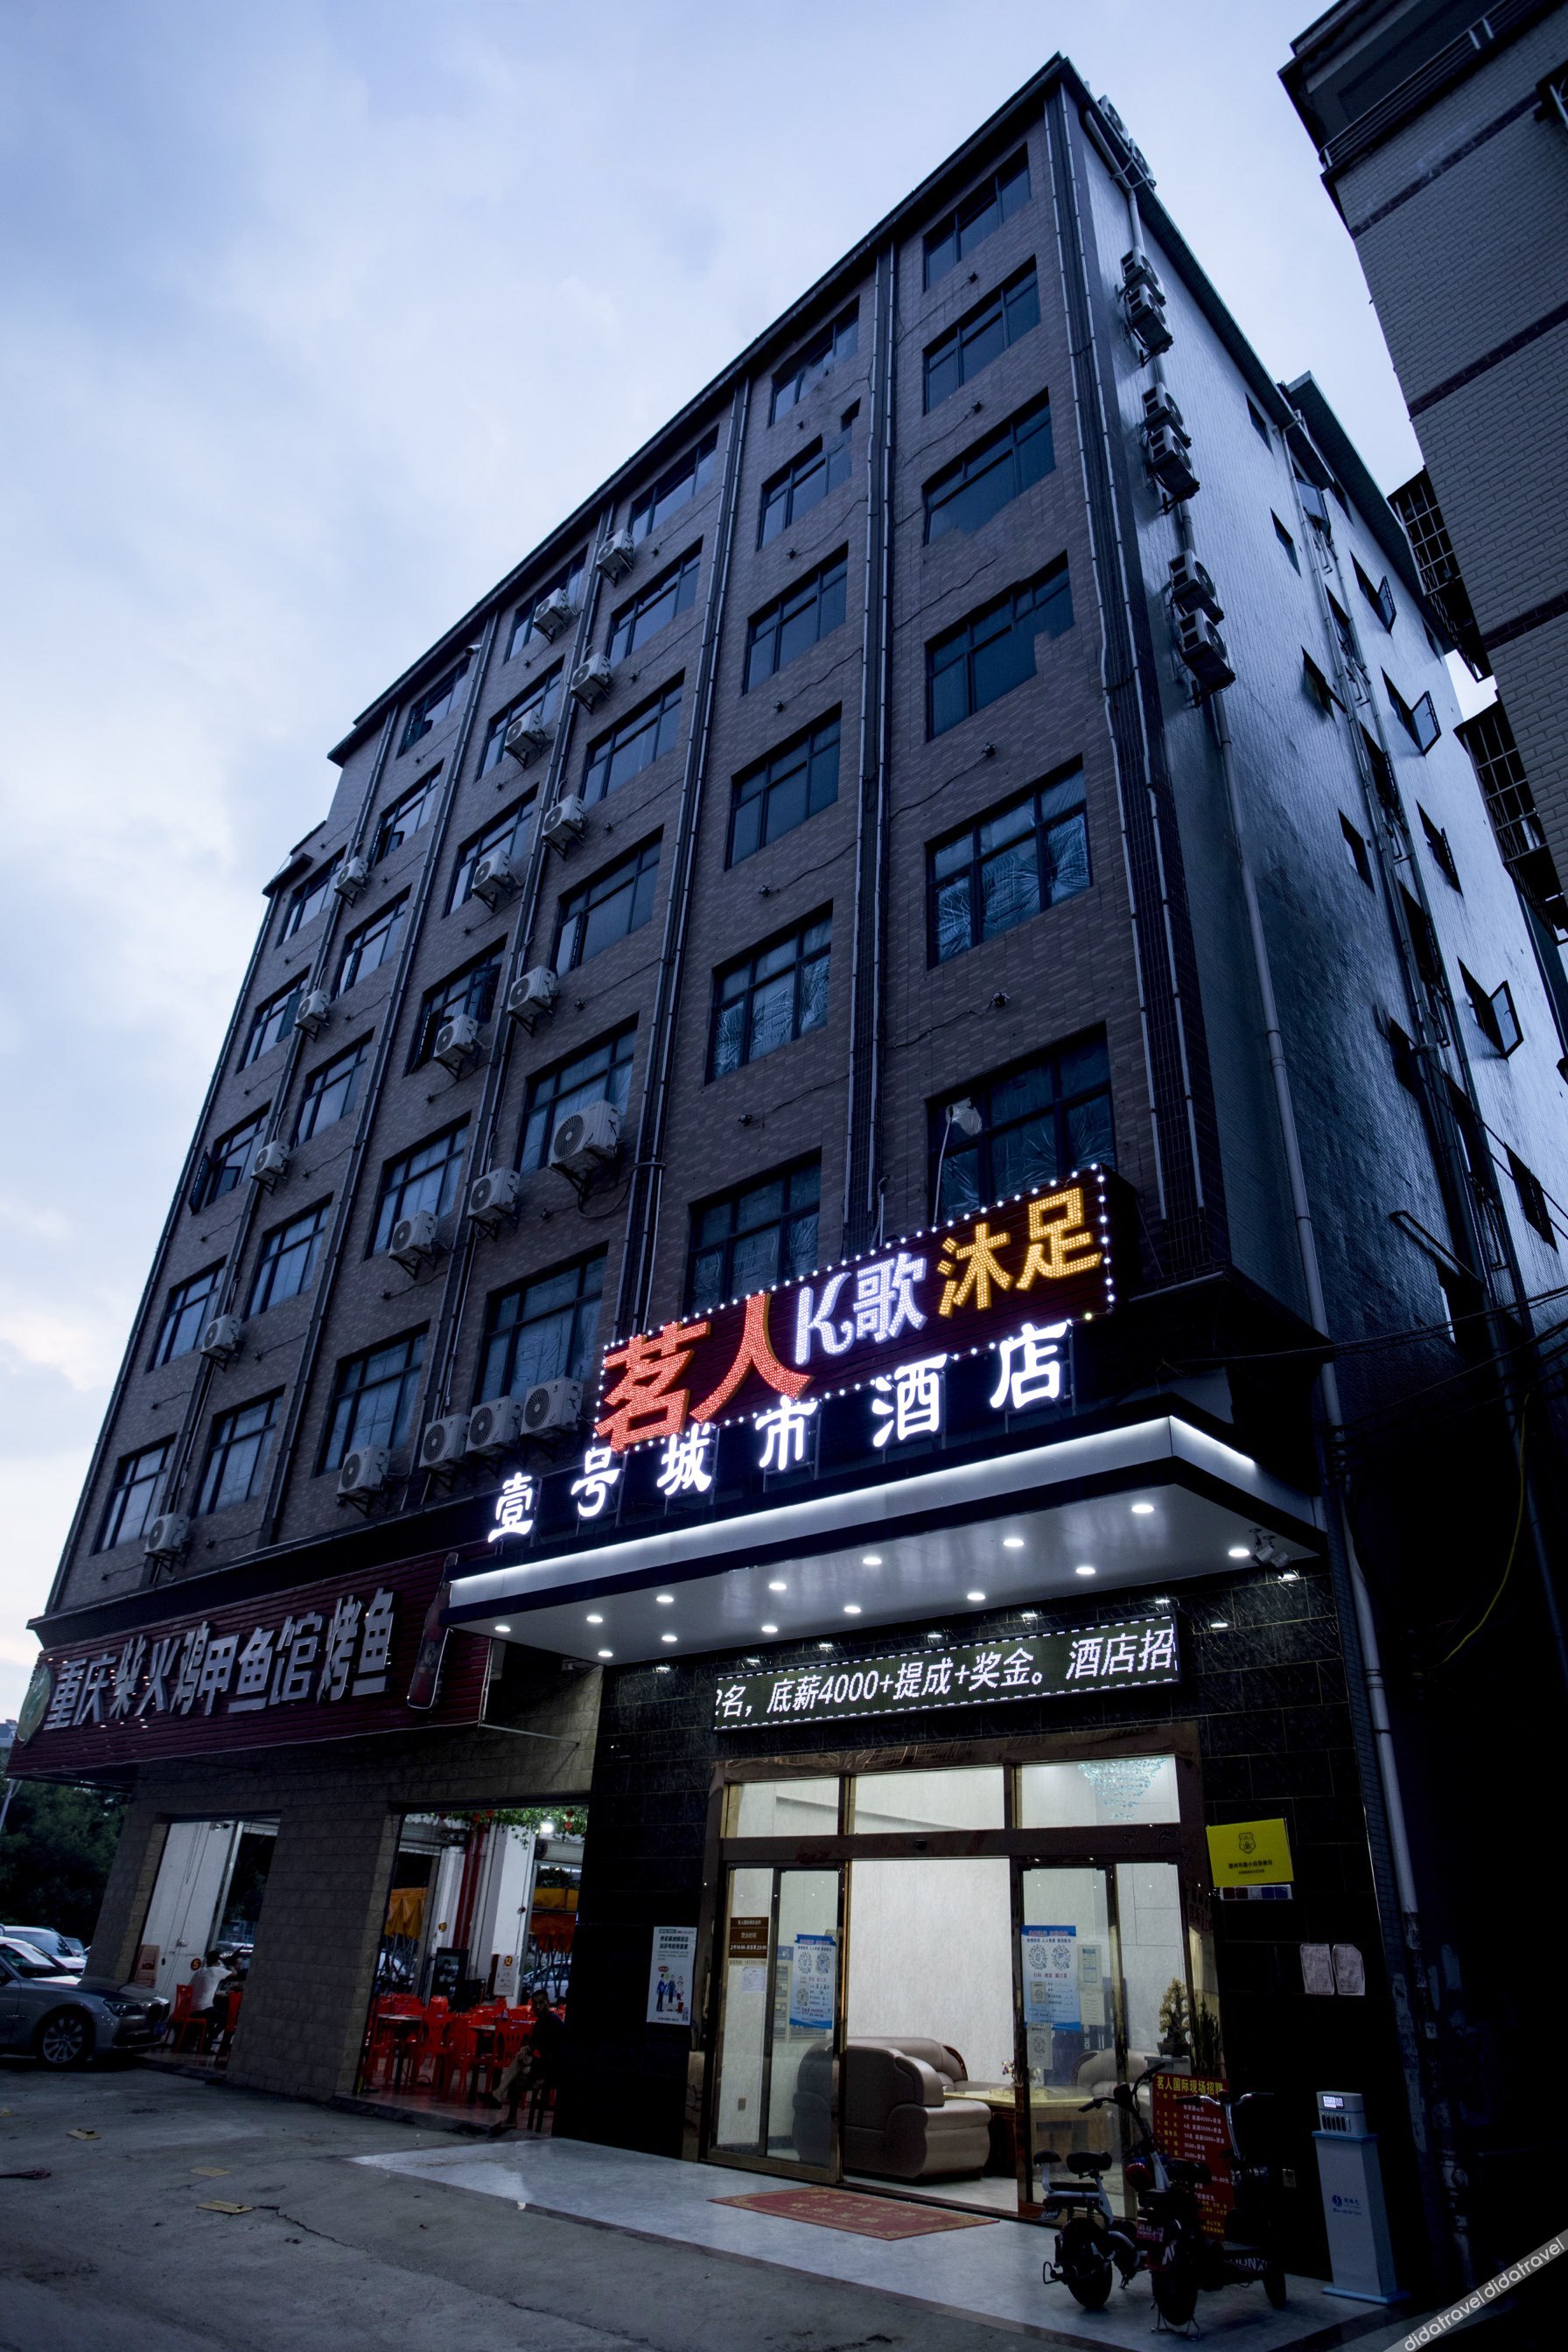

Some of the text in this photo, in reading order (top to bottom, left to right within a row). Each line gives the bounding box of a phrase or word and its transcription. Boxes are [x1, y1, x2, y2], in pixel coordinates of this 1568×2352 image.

[488, 1322, 1072, 1544] 壹号城市酒店
[43, 1587, 395, 1731] 重庆柴火鸡甲鱼馆烤鱼
[1066, 1628, 1174, 1680] 酒店招
